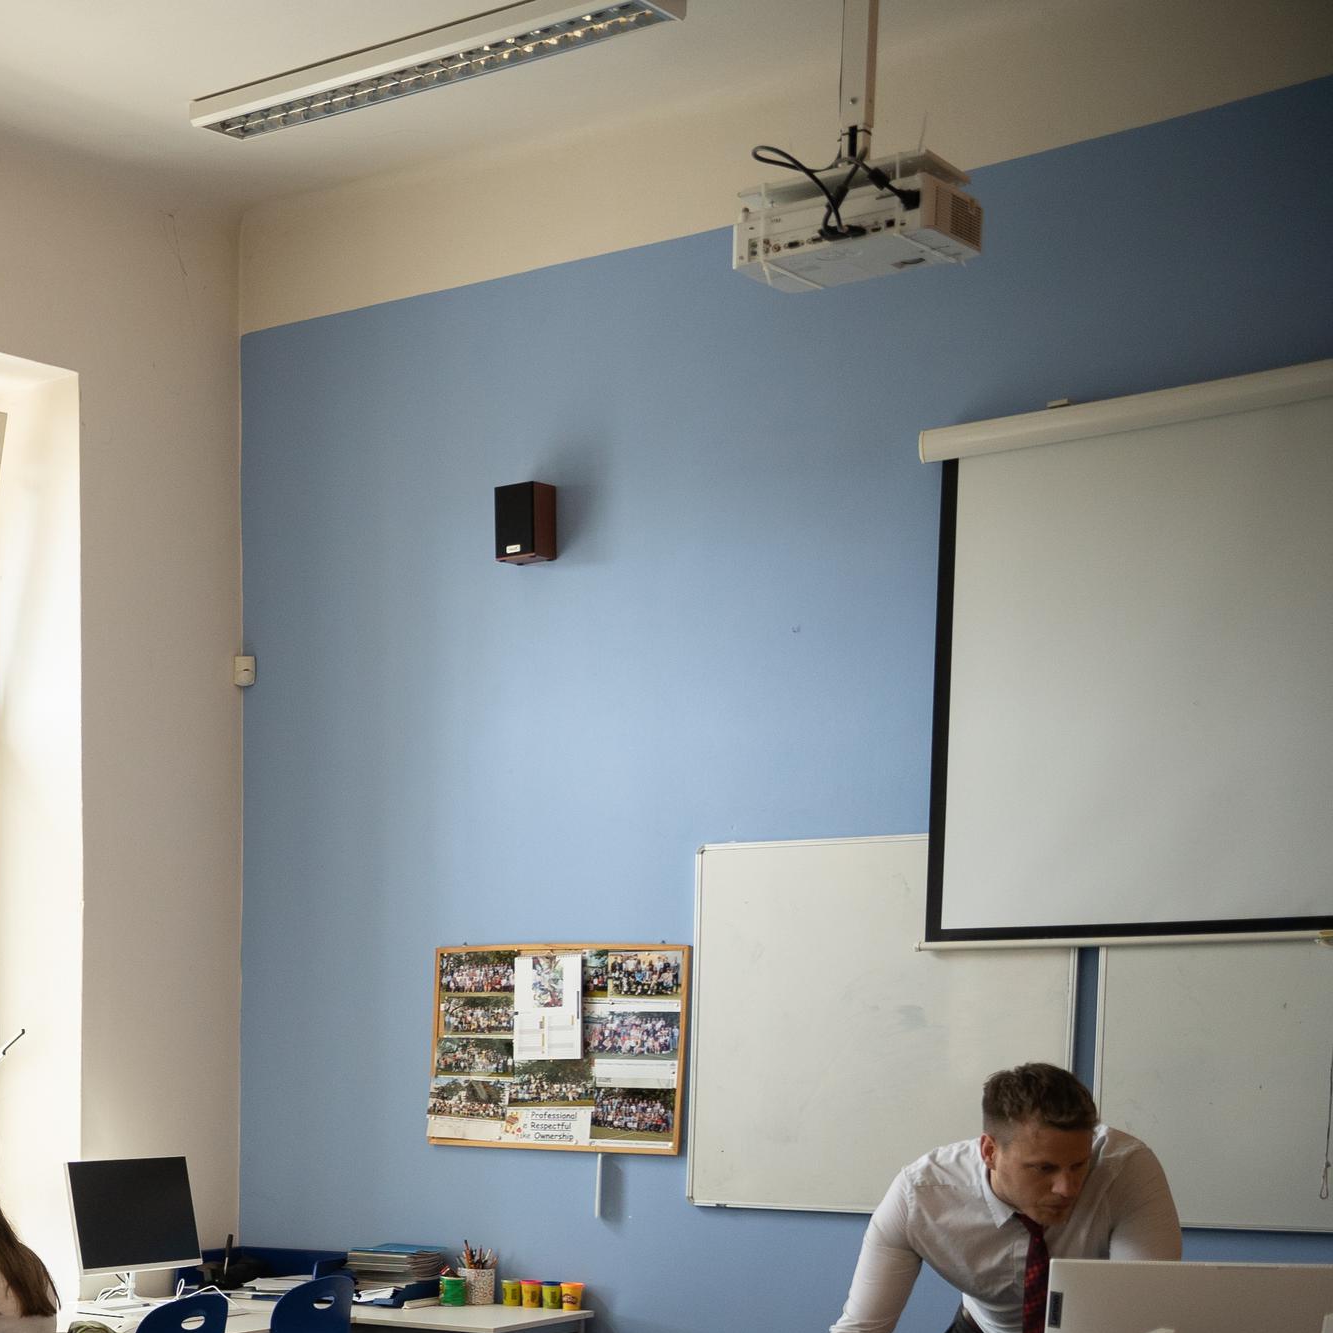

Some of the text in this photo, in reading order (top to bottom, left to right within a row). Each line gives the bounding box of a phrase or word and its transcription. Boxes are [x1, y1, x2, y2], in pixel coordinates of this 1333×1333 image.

[531, 1111, 577, 1120] Professional
[531, 1122, 571, 1131] Respectful
[534, 1132, 573, 1140] Ownership
